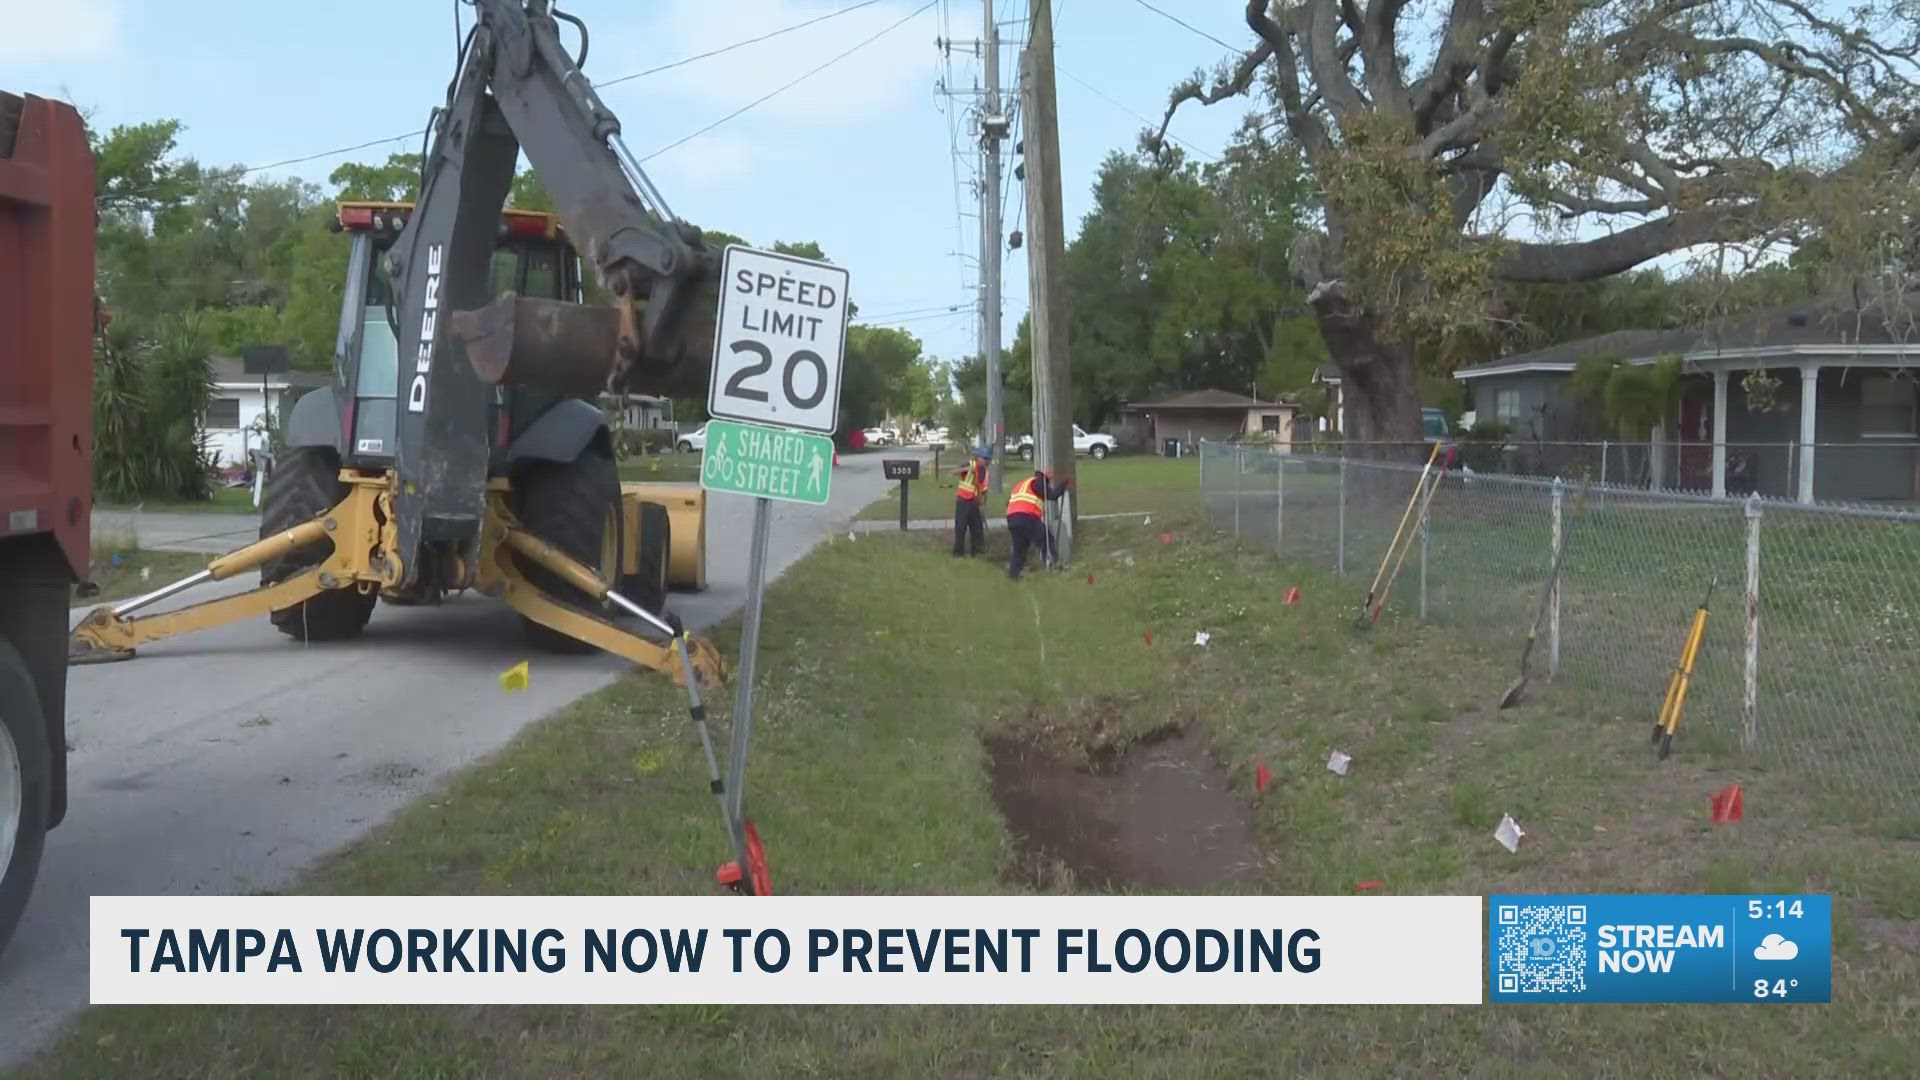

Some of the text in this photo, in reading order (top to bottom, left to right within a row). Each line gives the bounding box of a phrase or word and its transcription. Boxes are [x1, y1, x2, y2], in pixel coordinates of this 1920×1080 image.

[736, 269, 837, 310] SPEED
[409, 245, 442, 412] DEERE
[742, 305, 823, 341] LIMIT
[724, 339, 828, 410] 20
[737, 429, 805, 466] SHARED
[735, 462, 801, 496] STREET
